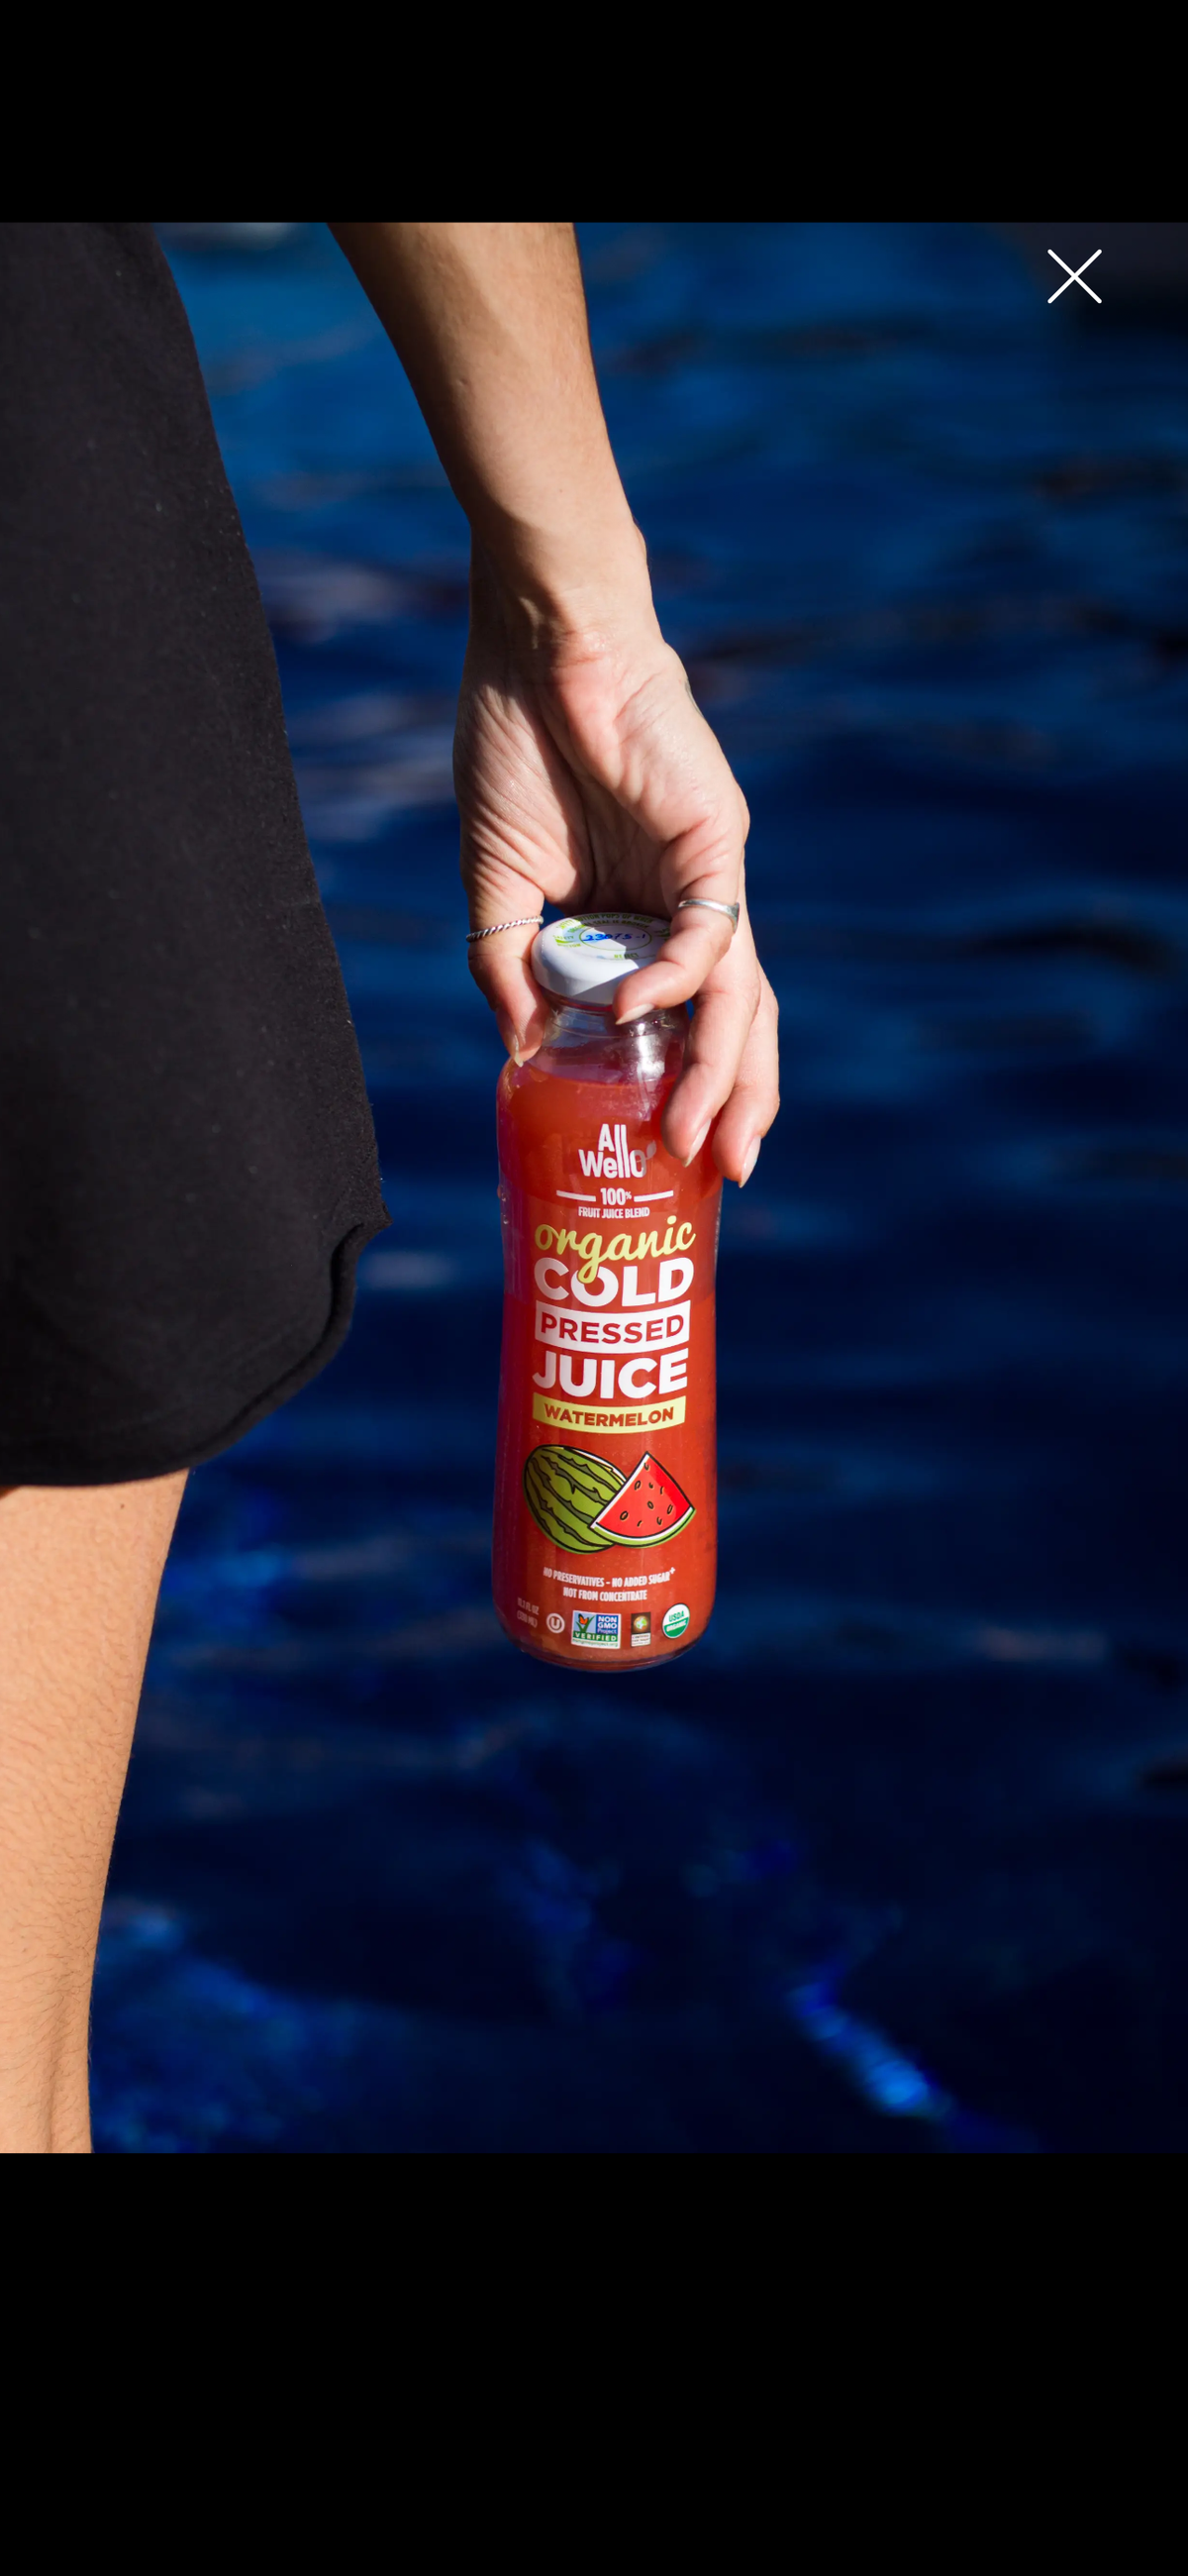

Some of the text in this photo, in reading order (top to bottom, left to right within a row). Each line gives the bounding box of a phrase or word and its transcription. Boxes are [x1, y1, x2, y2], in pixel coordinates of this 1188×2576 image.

[597, 1123, 629, 1153] All
[600, 1187, 633, 1205] 100%
[578, 1206, 650, 1219] FRUIT JUICE BLEND
[534, 1215, 697, 1285] organic
[534, 1257, 694, 1307] COLD
[541, 1311, 685, 1344] PRESSED
[532, 1347, 689, 1399] JUICE
[544, 1402, 674, 1427] WATERMELON
[543, 1567, 552, 1578] NO
[553, 1570, 605, 1588] PRESERVATIVES
[612, 1578, 623, 1588] NO
[624, 1576, 647, 1588] ADDED
[563, 1587, 647, 1601] NOT FROM CONCENTRATE
[668, 1610, 685, 1622] USDA
[575, 1632, 617, 1641] VERIFIED
